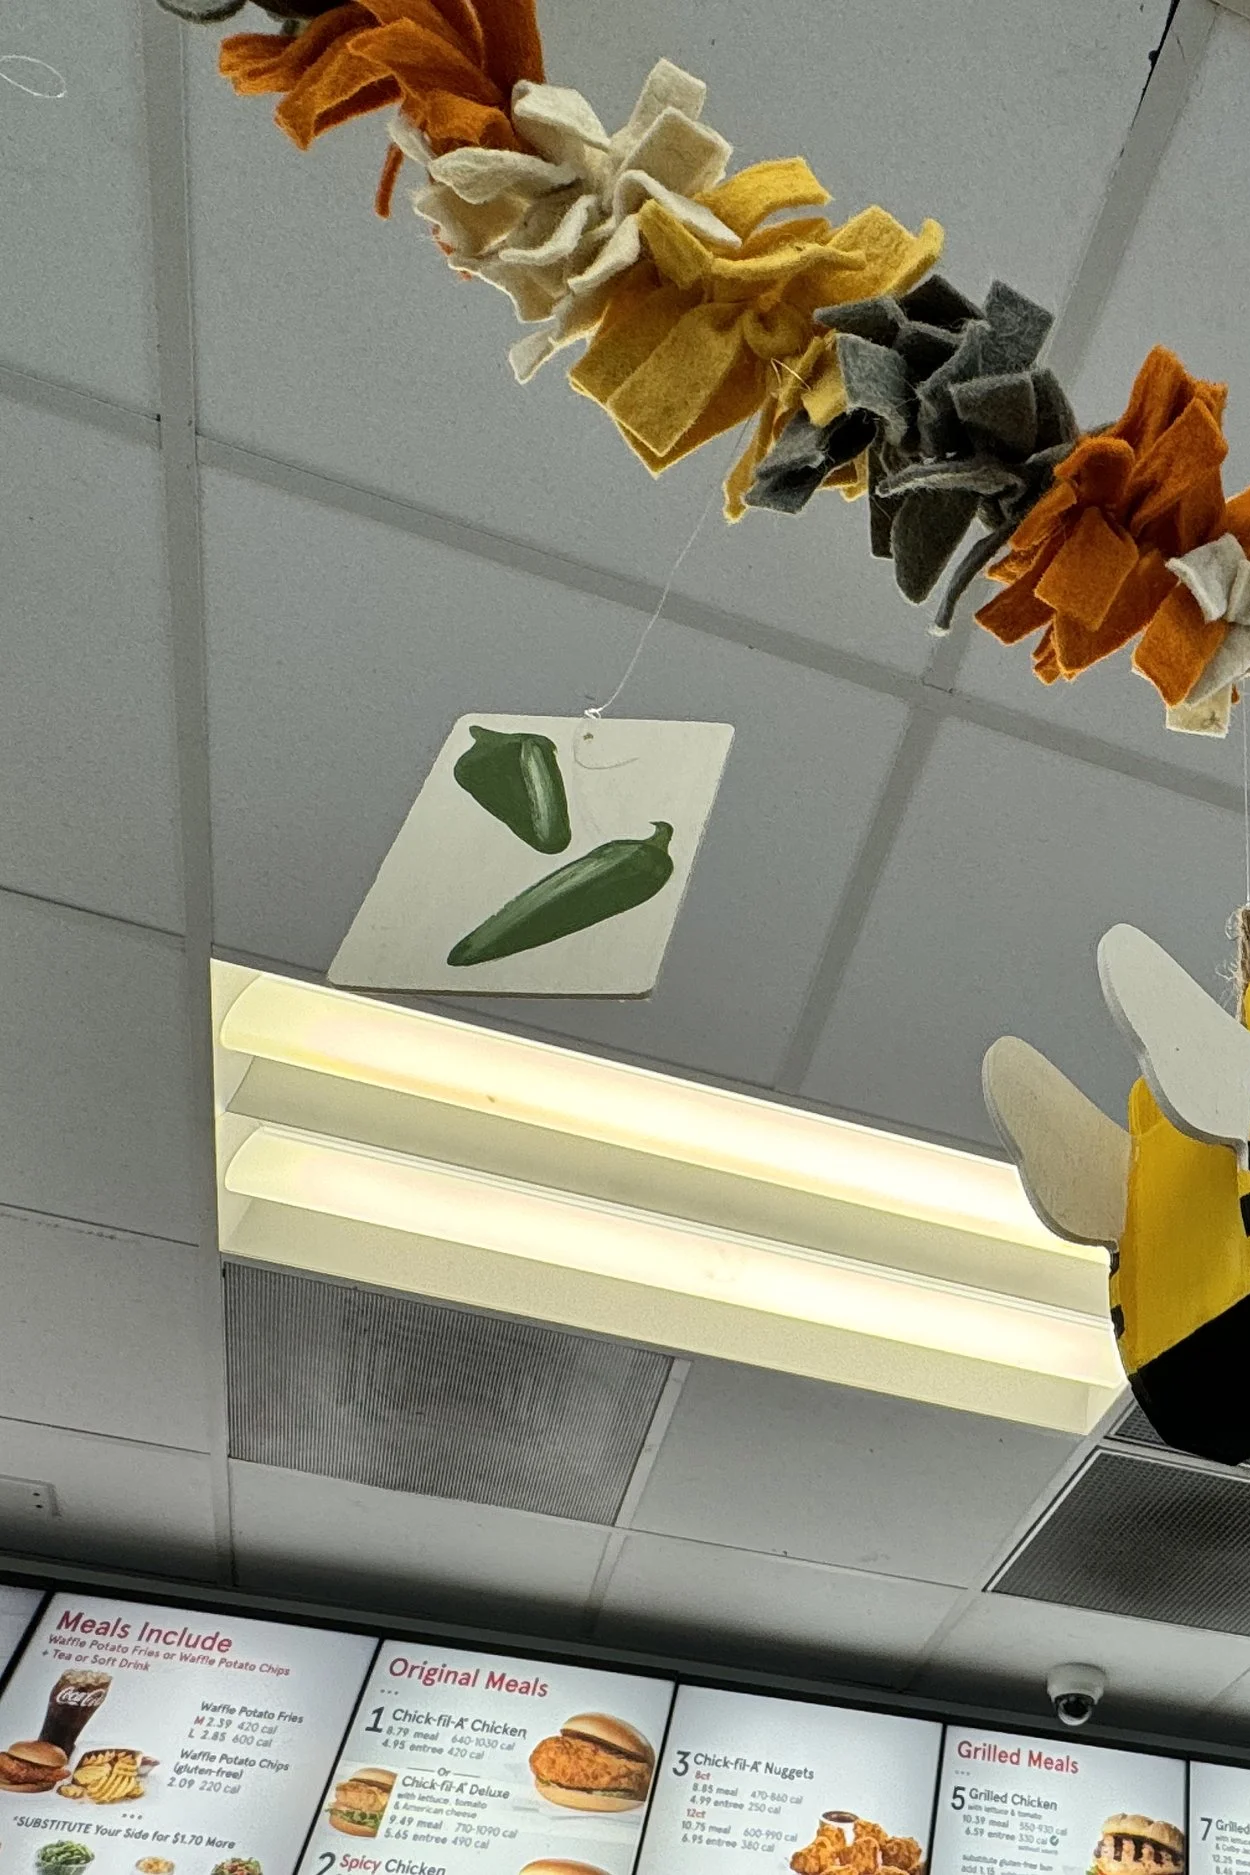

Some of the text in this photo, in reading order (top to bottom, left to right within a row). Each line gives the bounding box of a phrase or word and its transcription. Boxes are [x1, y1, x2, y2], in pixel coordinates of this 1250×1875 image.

[56, 1610, 232, 1652] Meals Include
[48, 1634, 290, 1676] Waffle Potato Fries or Waffle Potato Chips
[53, 1649, 73, 1661] Tea
[75, 1654, 89, 1663] or
[91, 1654, 117, 1667] Soft
[118, 1659, 150, 1672] Drink
[389, 1657, 549, 1697] Original Meals
[201, 1701, 304, 1724] Waffle Potato Fries
[365, 1706, 385, 1733] 1
[471, 1718, 528, 1739] Chicken
[194, 1716, 205, 1725] M
[238, 1721, 260, 1733] 420
[261, 1725, 278, 1735] cal
[188, 1728, 195, 1738] L
[232, 1734, 254, 1746] 600
[256, 1738, 273, 1748] cal
[386, 1726, 409, 1737] 8.79
[413, 1730, 440, 1741] meal
[499, 1742, 515, 1751] cal
[382, 1738, 485, 1760] 4.95 entree 420 cal
[957, 1740, 1079, 1774] Grilled Meals
[174, 1762, 244, 1780] (gluten-free)
[180, 1749, 289, 1773] Waffle Potato Chips
[437, 1767, 451, 1776] Or
[672, 1750, 691, 1776] 3
[764, 1762, 815, 1781] Nuggets
[167, 1777, 241, 1795] 2.09 220 cal
[695, 1770, 711, 1781] 8ct
[397, 1792, 416, 1800] with
[455, 1798, 487, 1809] tomato
[469, 1784, 511, 1799] Deluxe
[716, 1786, 739, 1797] meal
[790, 1796, 803, 1805] cal
[951, 1785, 1058, 1812] 5 Grilled Chicken
[394, 1801, 477, 1819] & American cheese
[686, 1808, 706, 1819] 12ct
[690, 1795, 712, 1805] 4.99
[713, 1799, 745, 1810] entree
[767, 1806, 782, 1815] cal
[94, 1825, 122, 1837] Your
[123, 1828, 150, 1840] Side
[151, 1831, 170, 1842] for
[172, 1832, 203, 1846] $1.70
[205, 1837, 236, 1849] More
[389, 1815, 414, 1826] 9.49
[416, 1820, 443, 1830] meal
[502, 1829, 518, 1839] cal
[708, 1824, 732, 1834] meal
[784, 1833, 798, 1843] cal
[988, 1830, 1016, 1841] entree
[1036, 1836, 1048, 1845] cal
[989, 1818, 1010, 1828] meal
[1055, 1828, 1068, 1836] cal
[1200, 1817, 1213, 1841] 7
[1215, 1819, 1250, 1835] Grilled
[384, 1828, 490, 1849] 5.65 entree 490 cal
[706, 1838, 737, 1849] entree
[761, 1843, 775, 1853] cal
[316, 1852, 446, 1875] 2 Spicy Chicken
